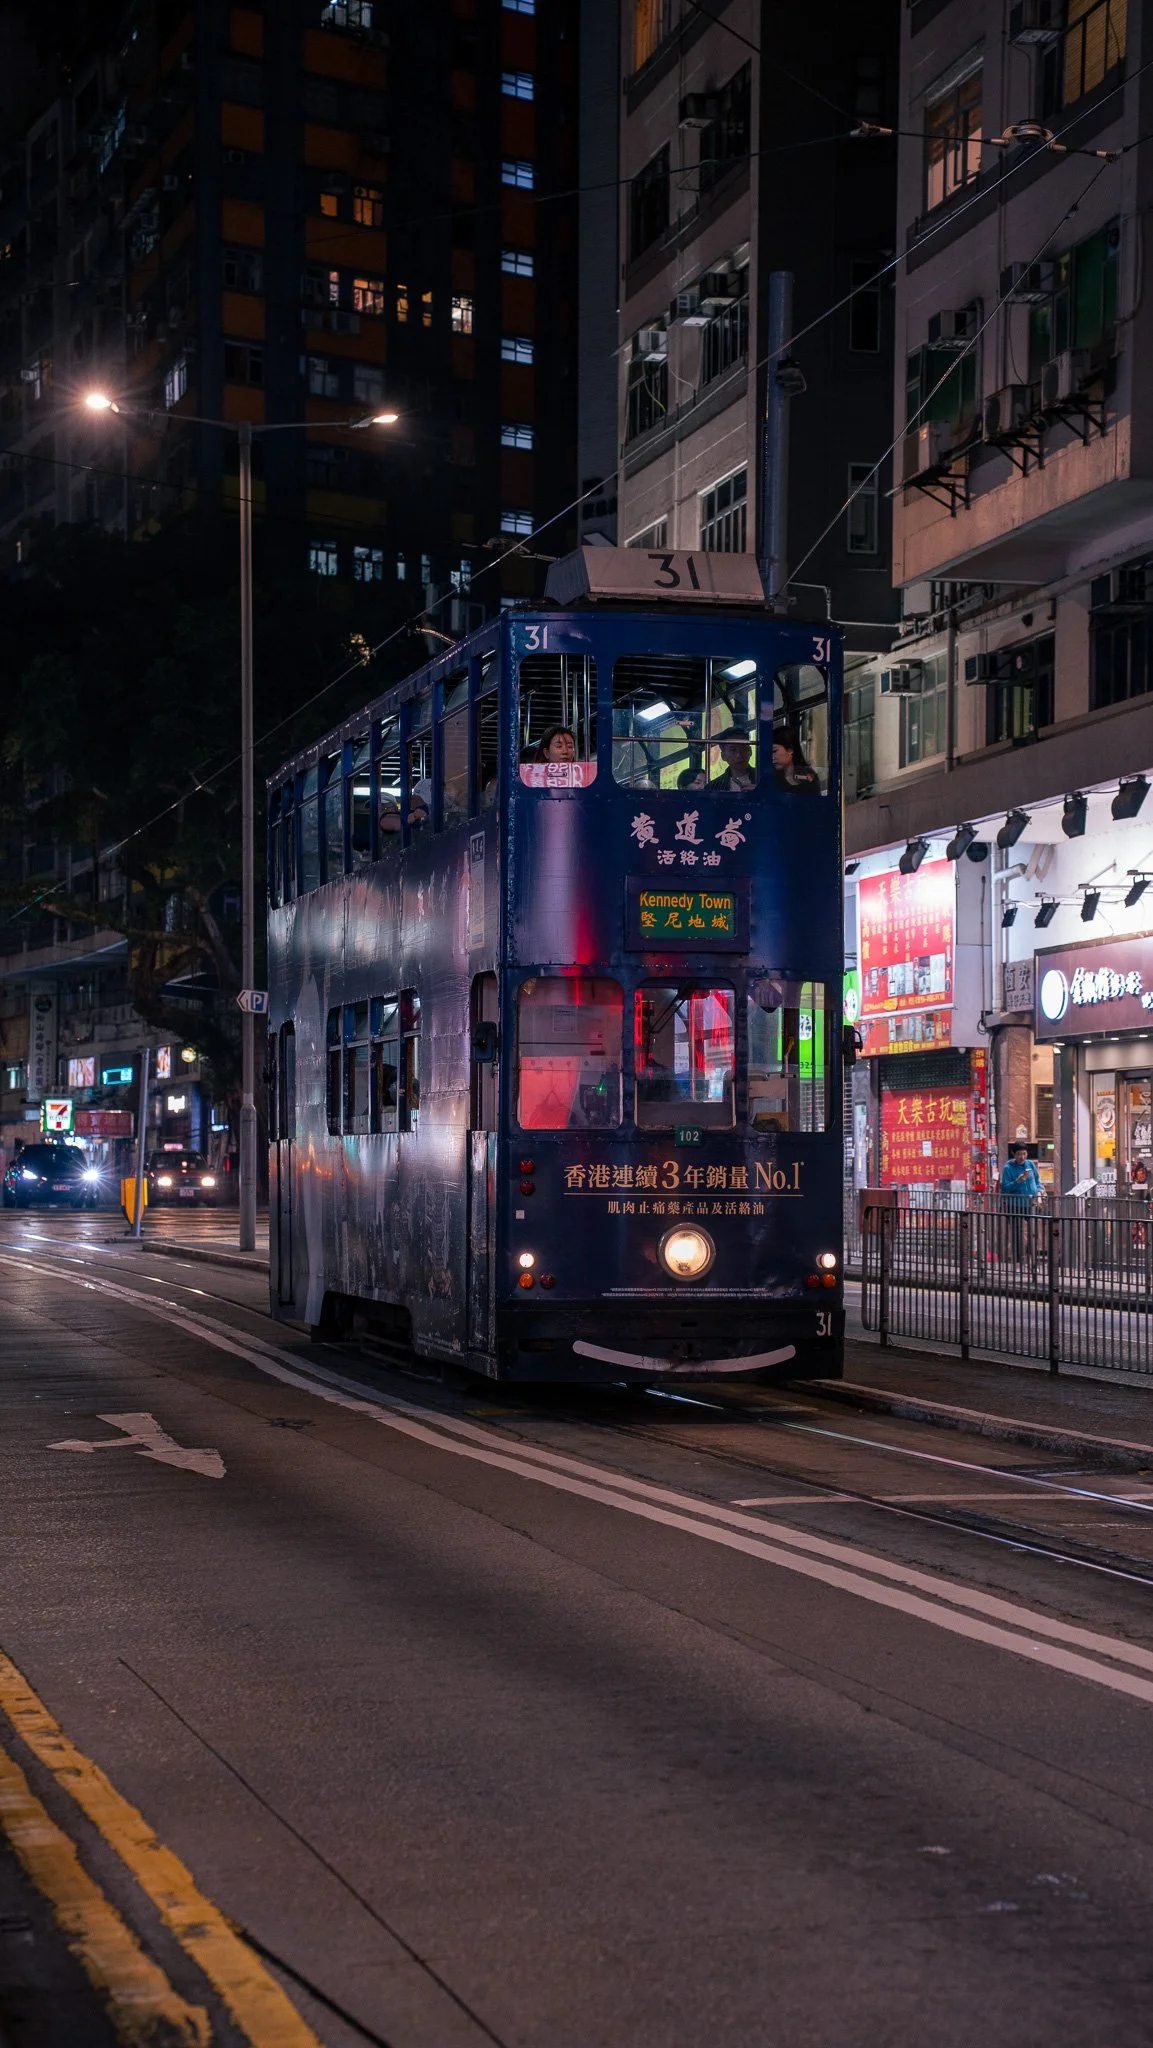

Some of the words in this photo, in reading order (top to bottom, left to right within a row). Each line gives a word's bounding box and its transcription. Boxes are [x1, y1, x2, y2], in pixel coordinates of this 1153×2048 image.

[648, 553, 700, 590] 31
[524, 625, 549, 651] 31
[812, 636, 831, 662] 31
[657, 850, 722, 867] 活絡油
[639, 892, 693, 911] Kennedy
[699, 892, 731, 909] Town
[641, 911, 729, 931] 堅尼地城
[253, 993, 263, 1007] P
[679, 1130, 699, 1142] 102
[563, 1160, 749, 1190] 香港連續3年銷量
[607, 1200, 765, 1216] 肌肉止痛藥產品及活絡油
[816, 1312, 832, 1337] 31
